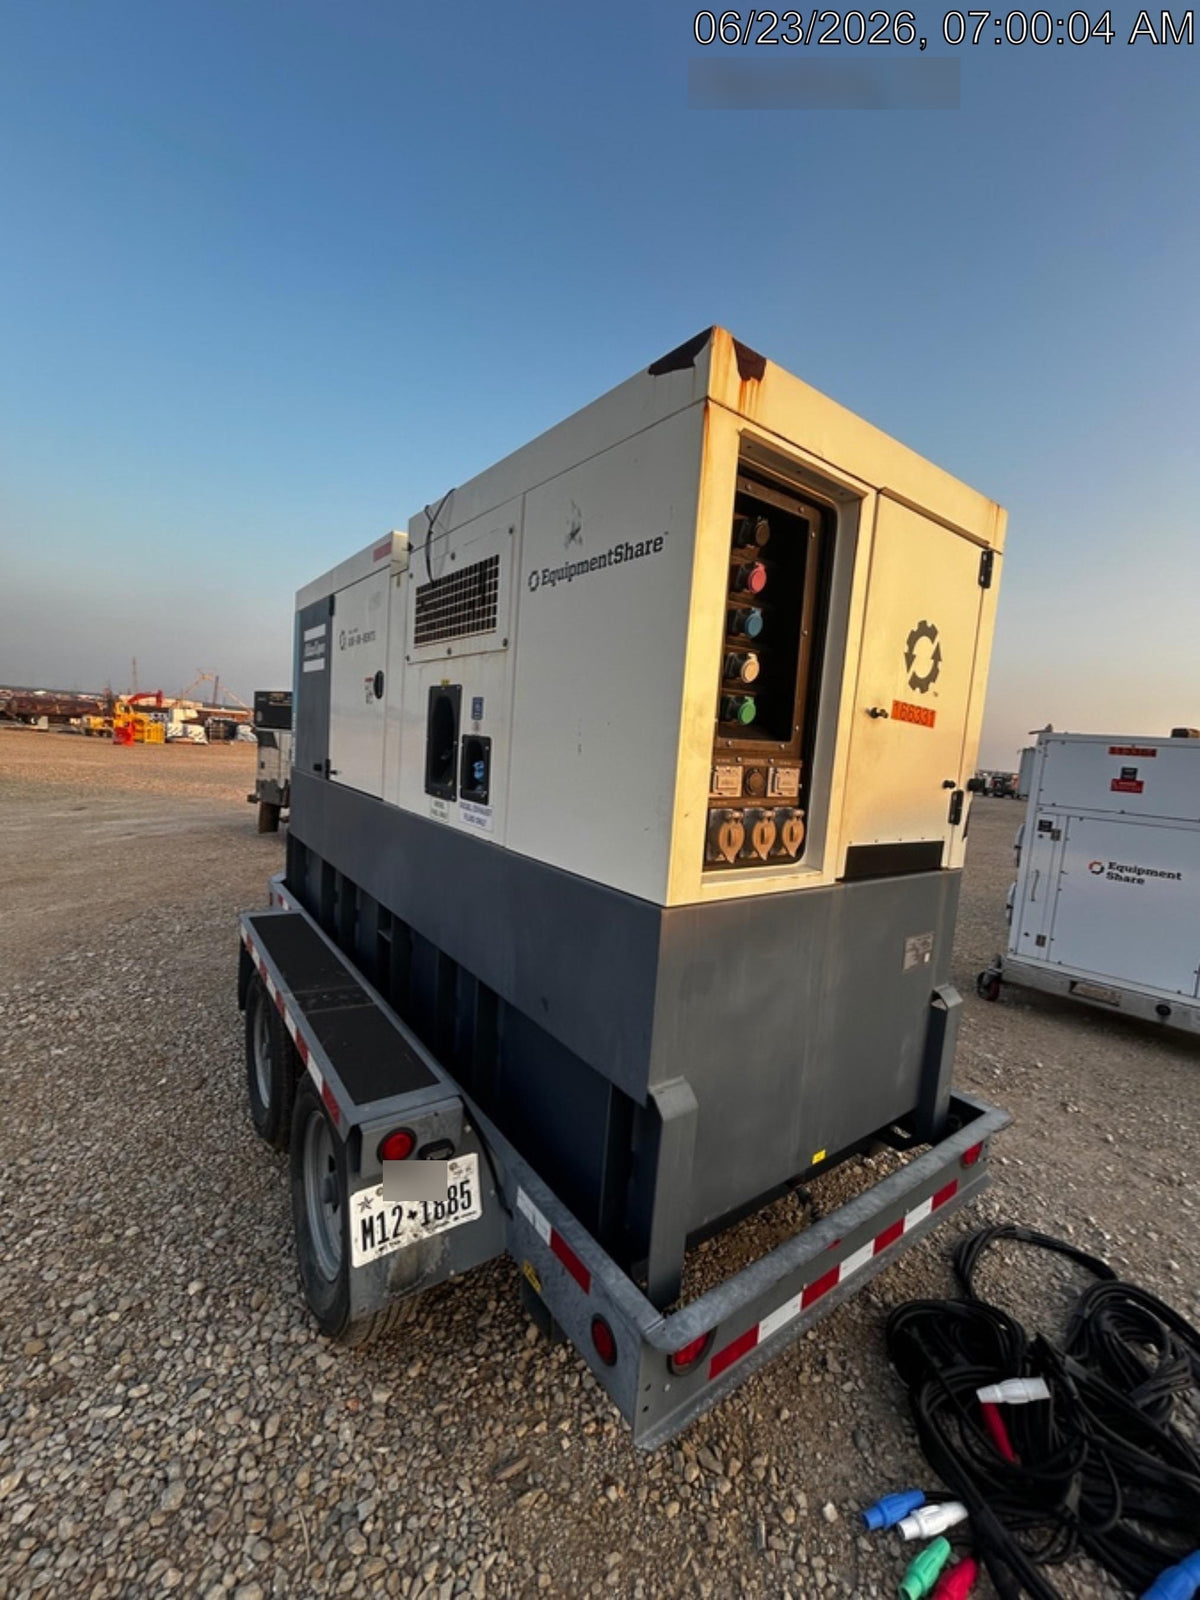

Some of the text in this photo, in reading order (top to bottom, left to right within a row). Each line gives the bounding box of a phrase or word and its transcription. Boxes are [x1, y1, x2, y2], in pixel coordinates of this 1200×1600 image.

[541, 535, 664, 587] EquipmentShare
[1105, 871, 1145, 885] Share
[1107, 861, 1182, 882] Equipment
